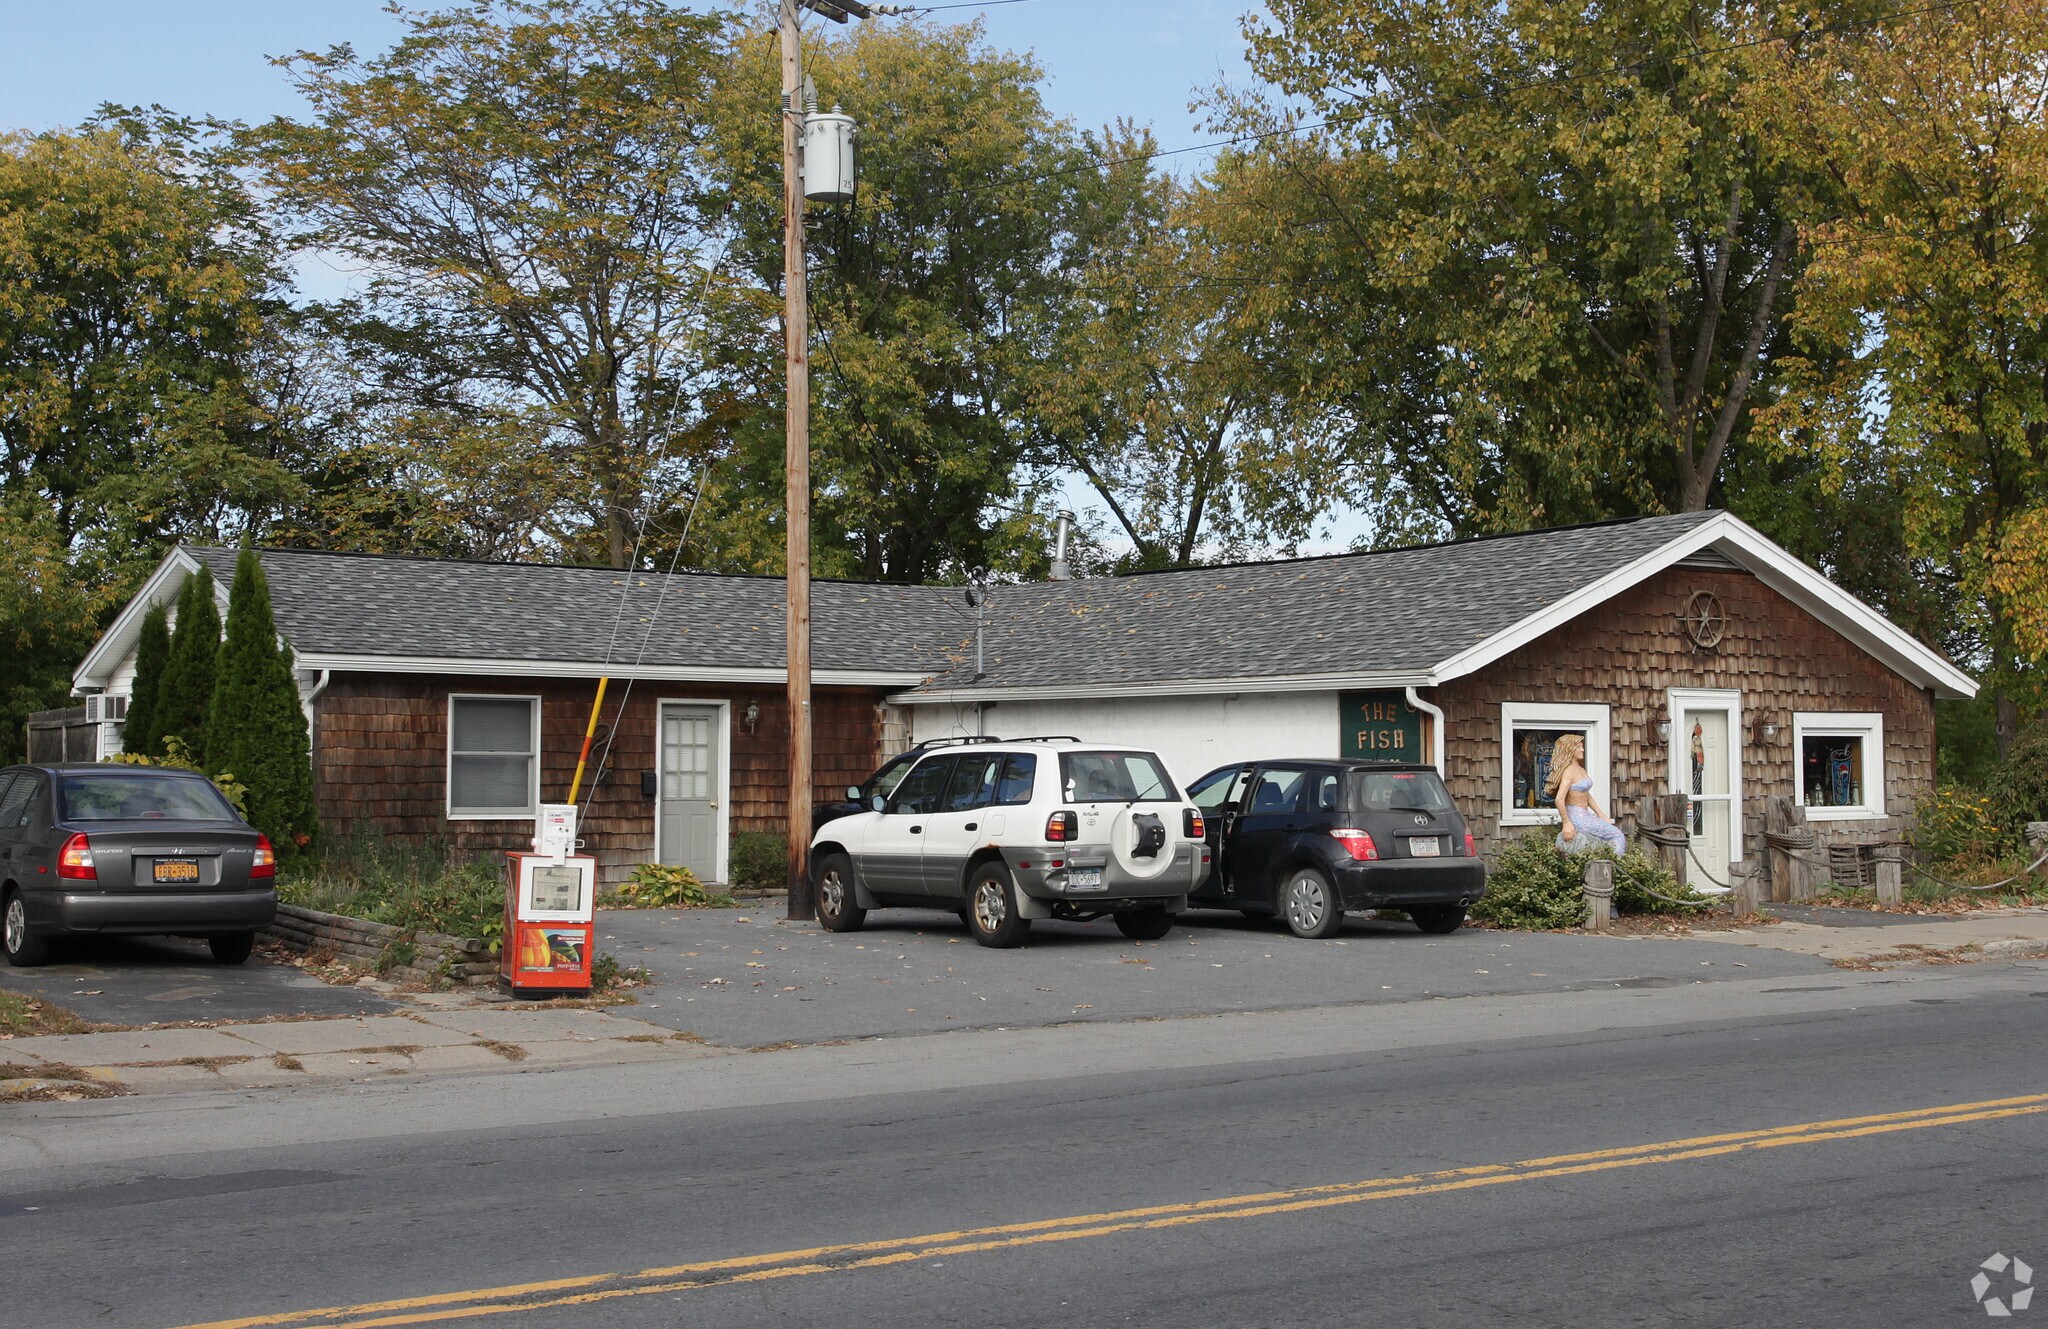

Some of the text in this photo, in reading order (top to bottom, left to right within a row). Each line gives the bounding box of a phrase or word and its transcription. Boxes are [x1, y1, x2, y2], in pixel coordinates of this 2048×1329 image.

[843, 180, 852, 189] 25
[1360, 702, 1398, 723] THE
[1357, 728, 1404, 750] FISH
